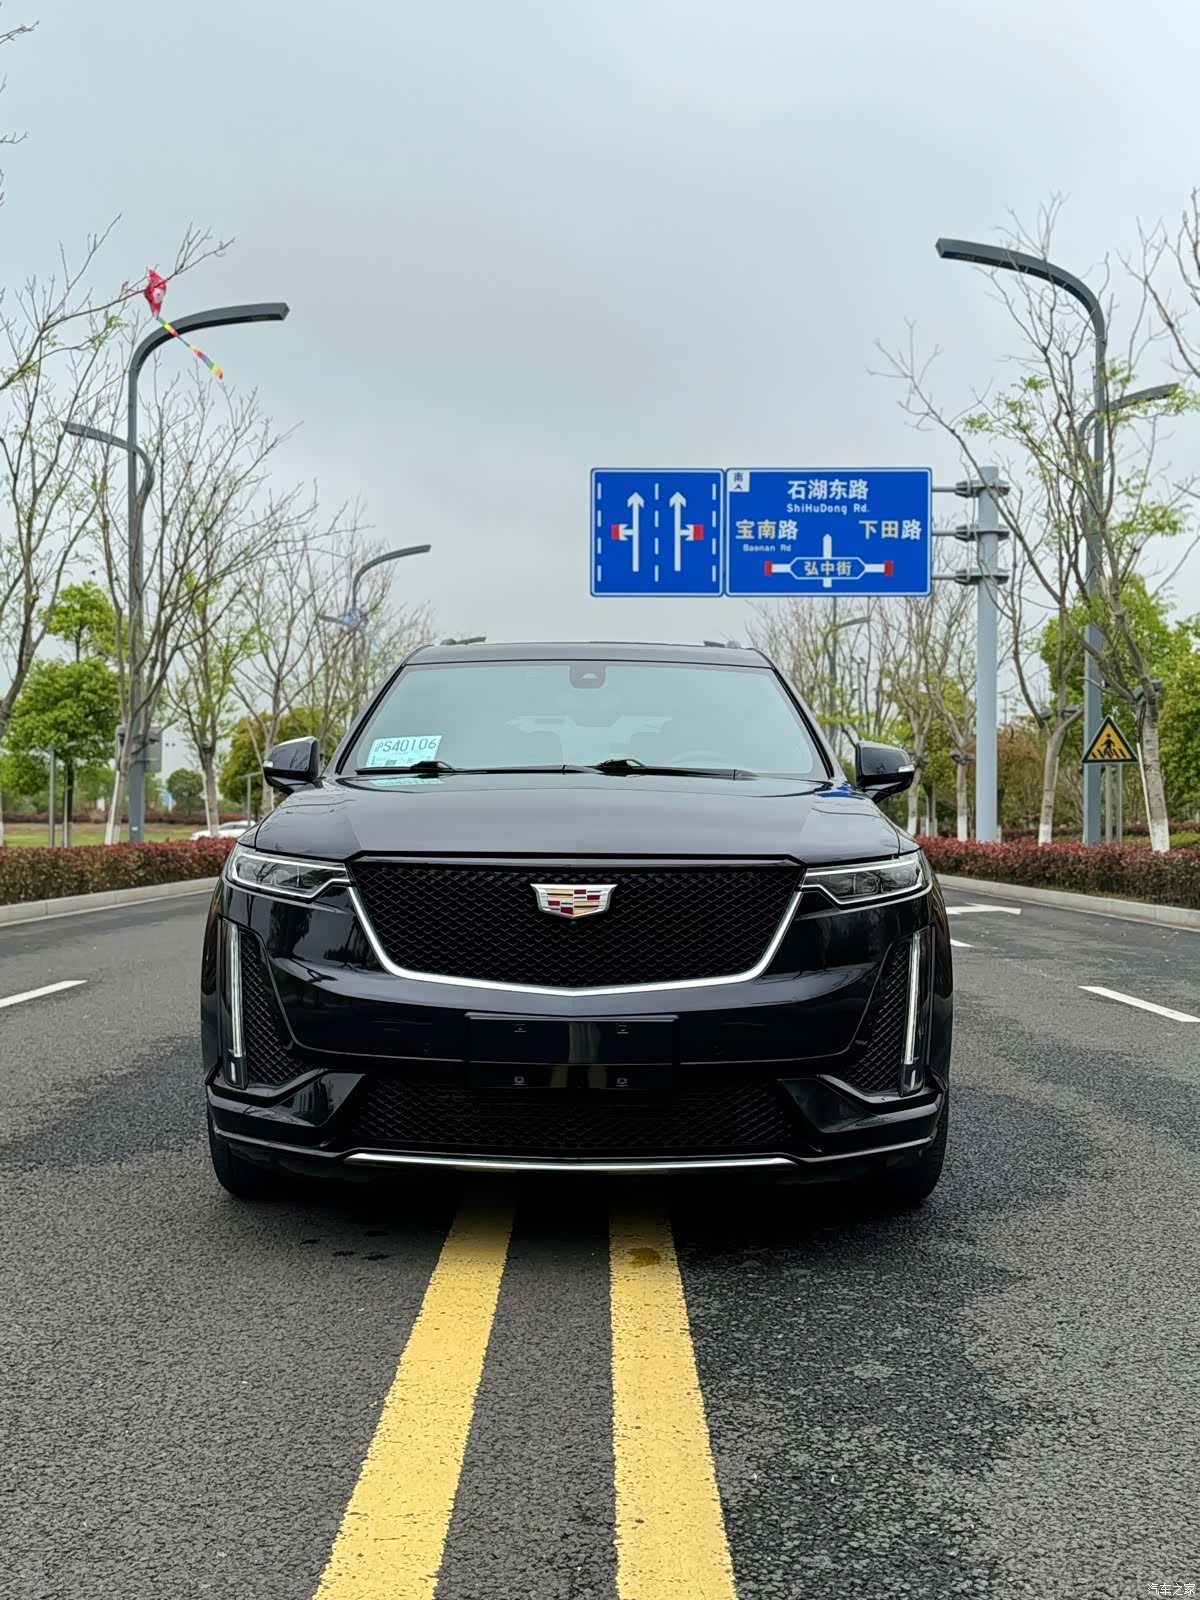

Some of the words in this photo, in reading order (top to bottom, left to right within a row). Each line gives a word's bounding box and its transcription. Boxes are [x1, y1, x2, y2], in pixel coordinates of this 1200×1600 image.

[733, 471, 744, 481] 南
[787, 478, 869, 500] 石湖东路
[786, 503, 848, 516] ShiHuDong
[853, 503, 870, 513] Rd.
[735, 519, 799, 541] 宝南路
[858, 519, 922, 540] 下田路
[743, 543, 776, 552] Baonan
[804, 560, 852, 576] 弘中街
